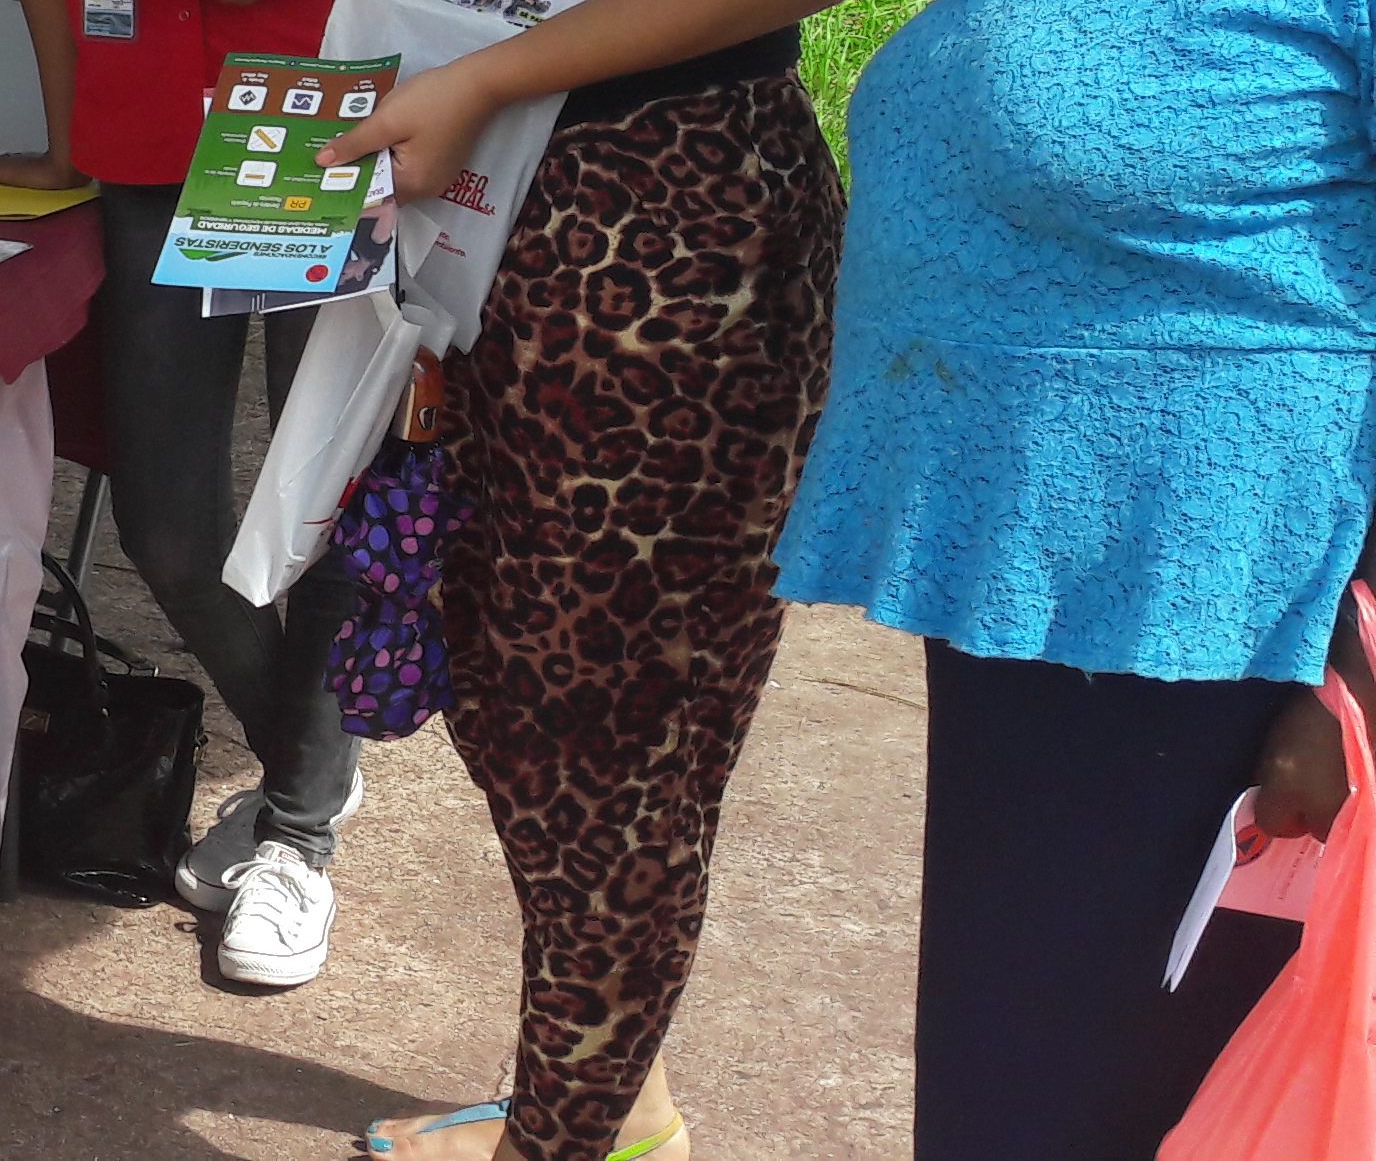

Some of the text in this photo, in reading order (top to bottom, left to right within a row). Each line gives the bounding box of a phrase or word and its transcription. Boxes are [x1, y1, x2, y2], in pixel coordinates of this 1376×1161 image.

[458, 168, 489, 193] SEO
[197, 221, 260, 232] SEGURIDAD
[260, 224, 276, 234] DE
[277, 225, 328, 235] MEDIDAS
[174, 237, 333, 254] A LOS SENDERISTAS
